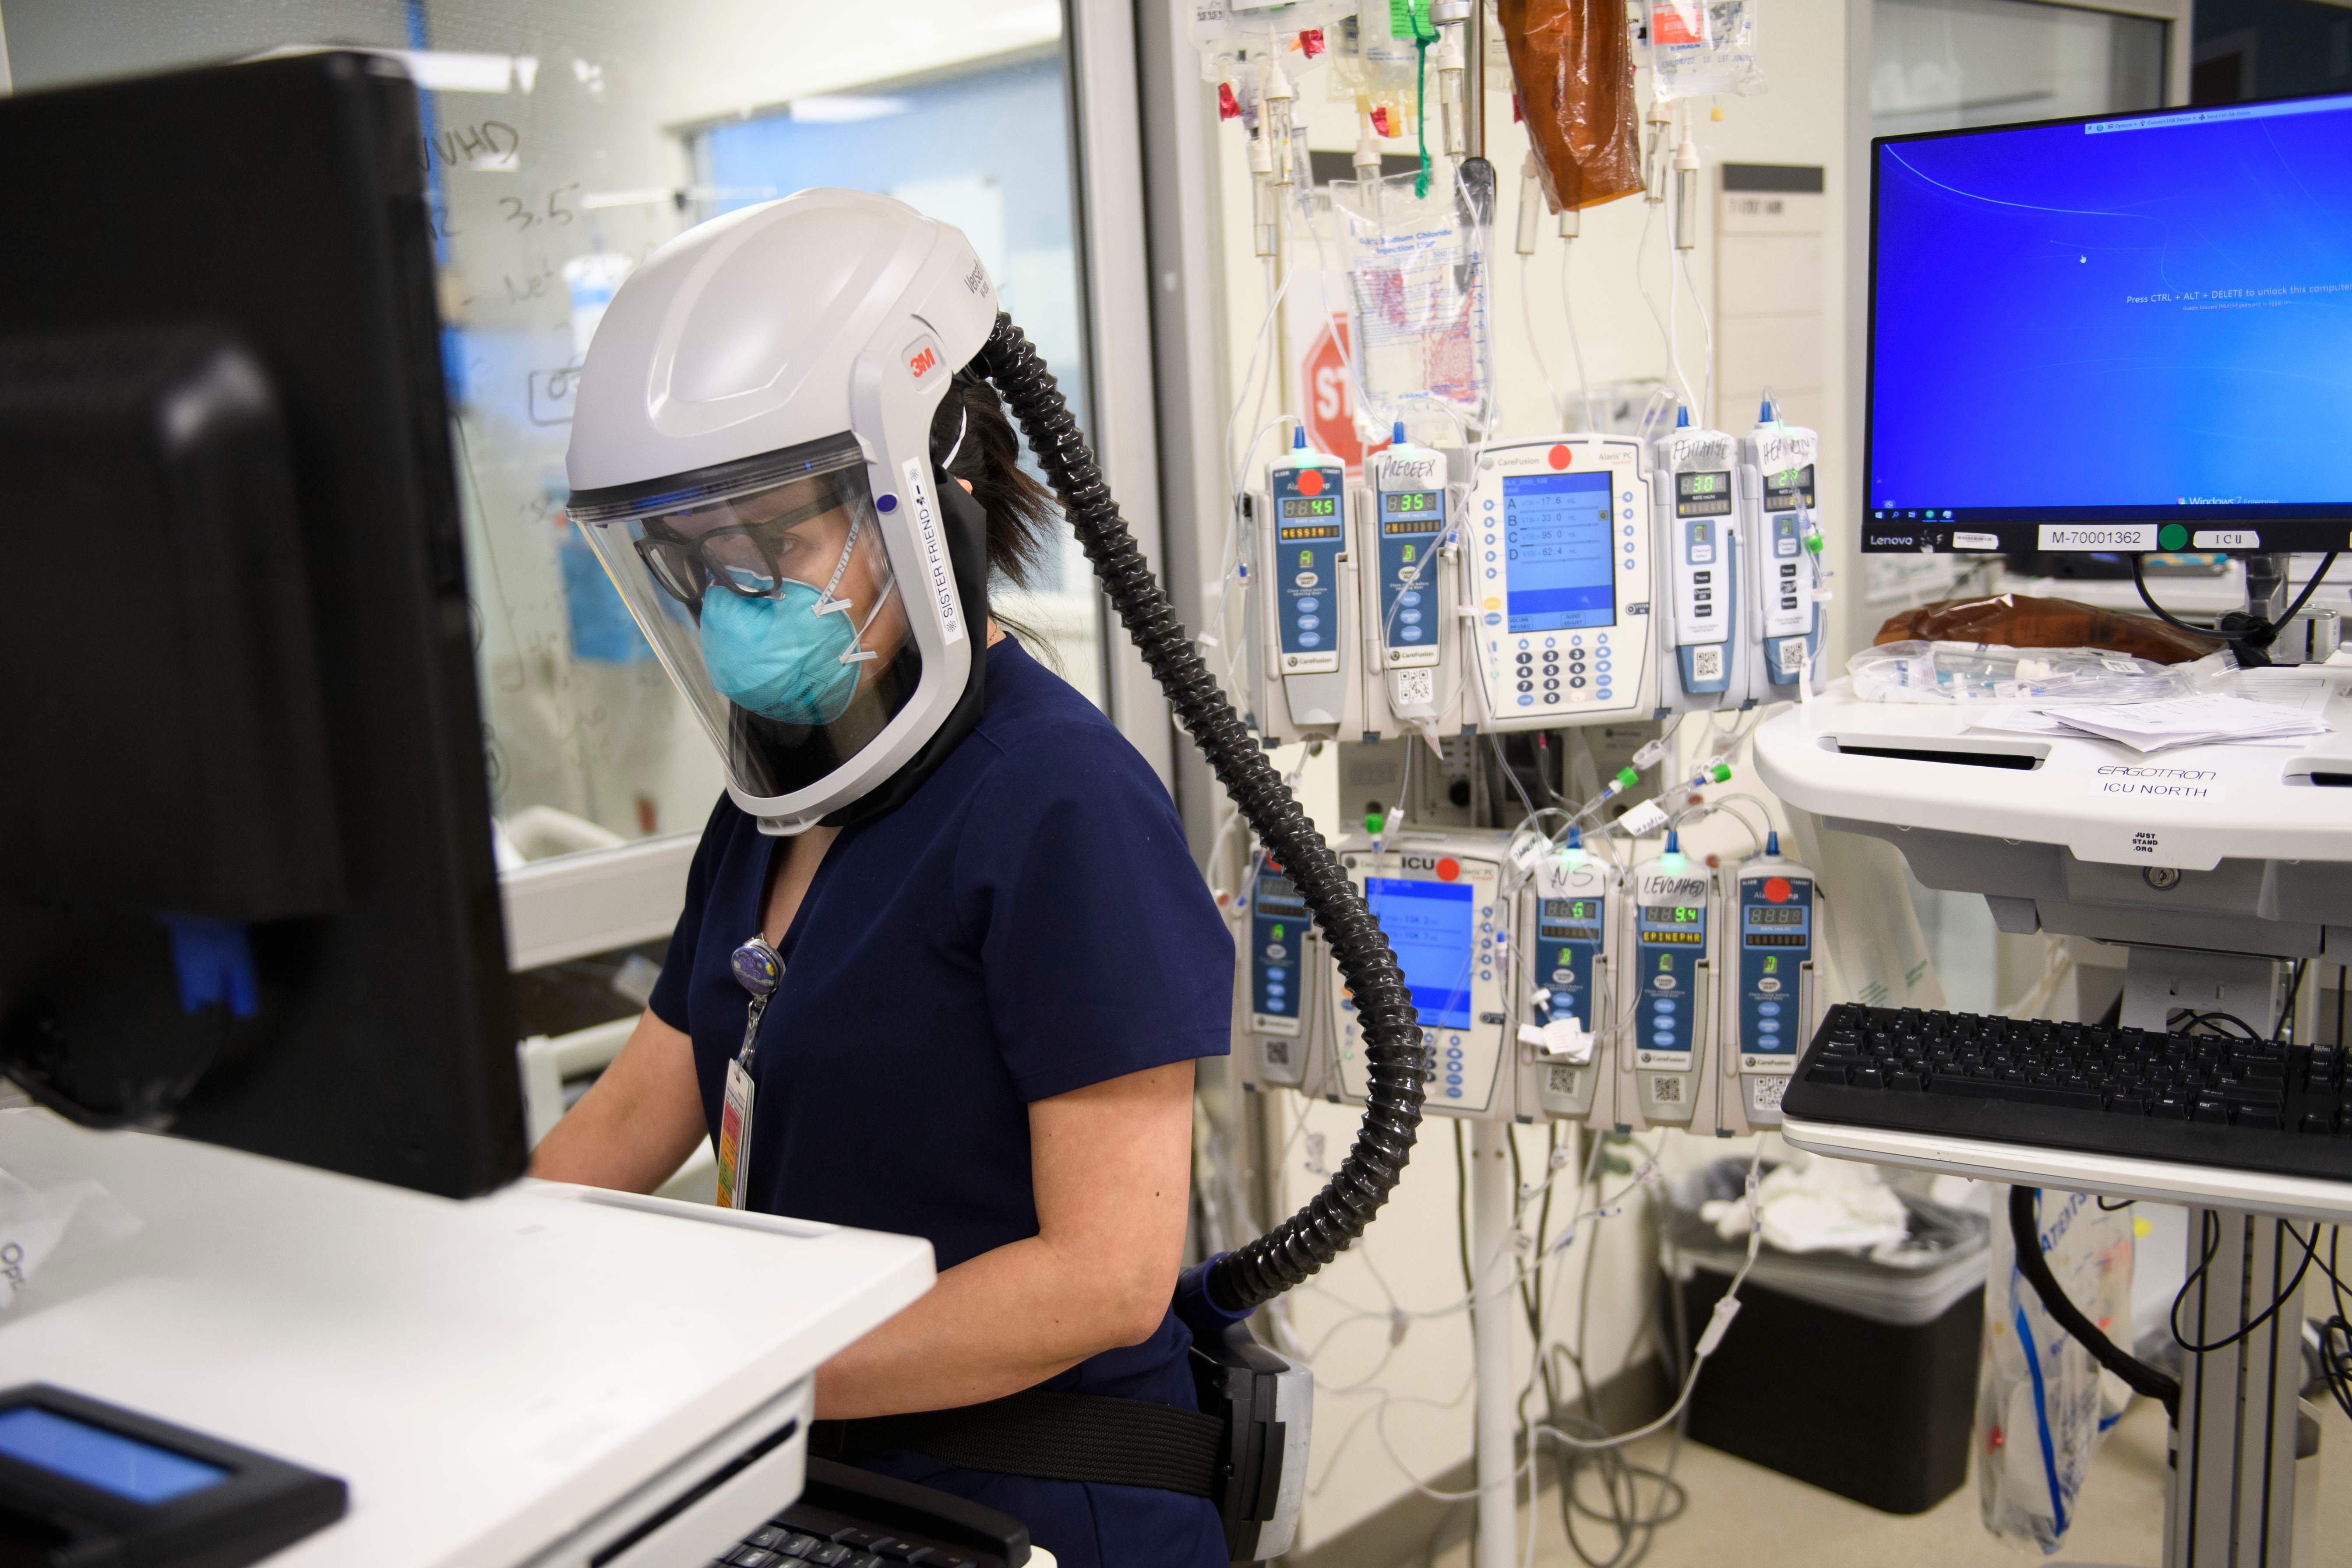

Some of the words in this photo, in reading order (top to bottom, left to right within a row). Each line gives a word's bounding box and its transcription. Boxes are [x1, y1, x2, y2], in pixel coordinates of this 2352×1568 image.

[499, 183, 581, 231] 3.5
[1416, 230, 1453, 239] Chloride
[1376, 245, 1414, 255] Injection
[2127, 296, 2148, 304] Press
[2151, 293, 2172, 302] CTRL
[2183, 292, 2199, 300] ALT
[2212, 289, 2243, 298] DELETE
[2258, 286, 2287, 296] unlock
[2291, 285, 2306, 294] this
[910, 347, 936, 377] 3M
[1317, 366, 1354, 421] ST
[1498, 458, 1540, 466] CareFusion
[1693, 476, 1714, 493] 30
[1401, 494, 1423, 511] 35
[1508, 498, 1516, 509] A
[1542, 497, 1561, 505] 17.6
[1508, 515, 1517, 526] B
[1542, 513, 1562, 522] 33.0
[1283, 528, 1324, 538] RESSIN
[1509, 532, 1517, 543] C
[1542, 530, 1562, 539] 95.0
[2052, 531, 2141, 544] M-70001362
[1870, 535, 1913, 546] Lenovo
[1300, 550, 1311, 564] A
[1509, 549, 1518, 560] D
[1542, 547, 1562, 556] 62.4
[2098, 765, 2216, 781] ERGOTRON
[2104, 783, 2135, 793] ICU
[2140, 785, 2207, 797] NORTH
[1401, 857, 1435, 870] ICU
[1552, 860, 1594, 888] NS
[1675, 906, 1696, 922] 9.4
[1643, 932, 1700, 942] EPINEPHR
[1660, 953, 1671, 969] C
